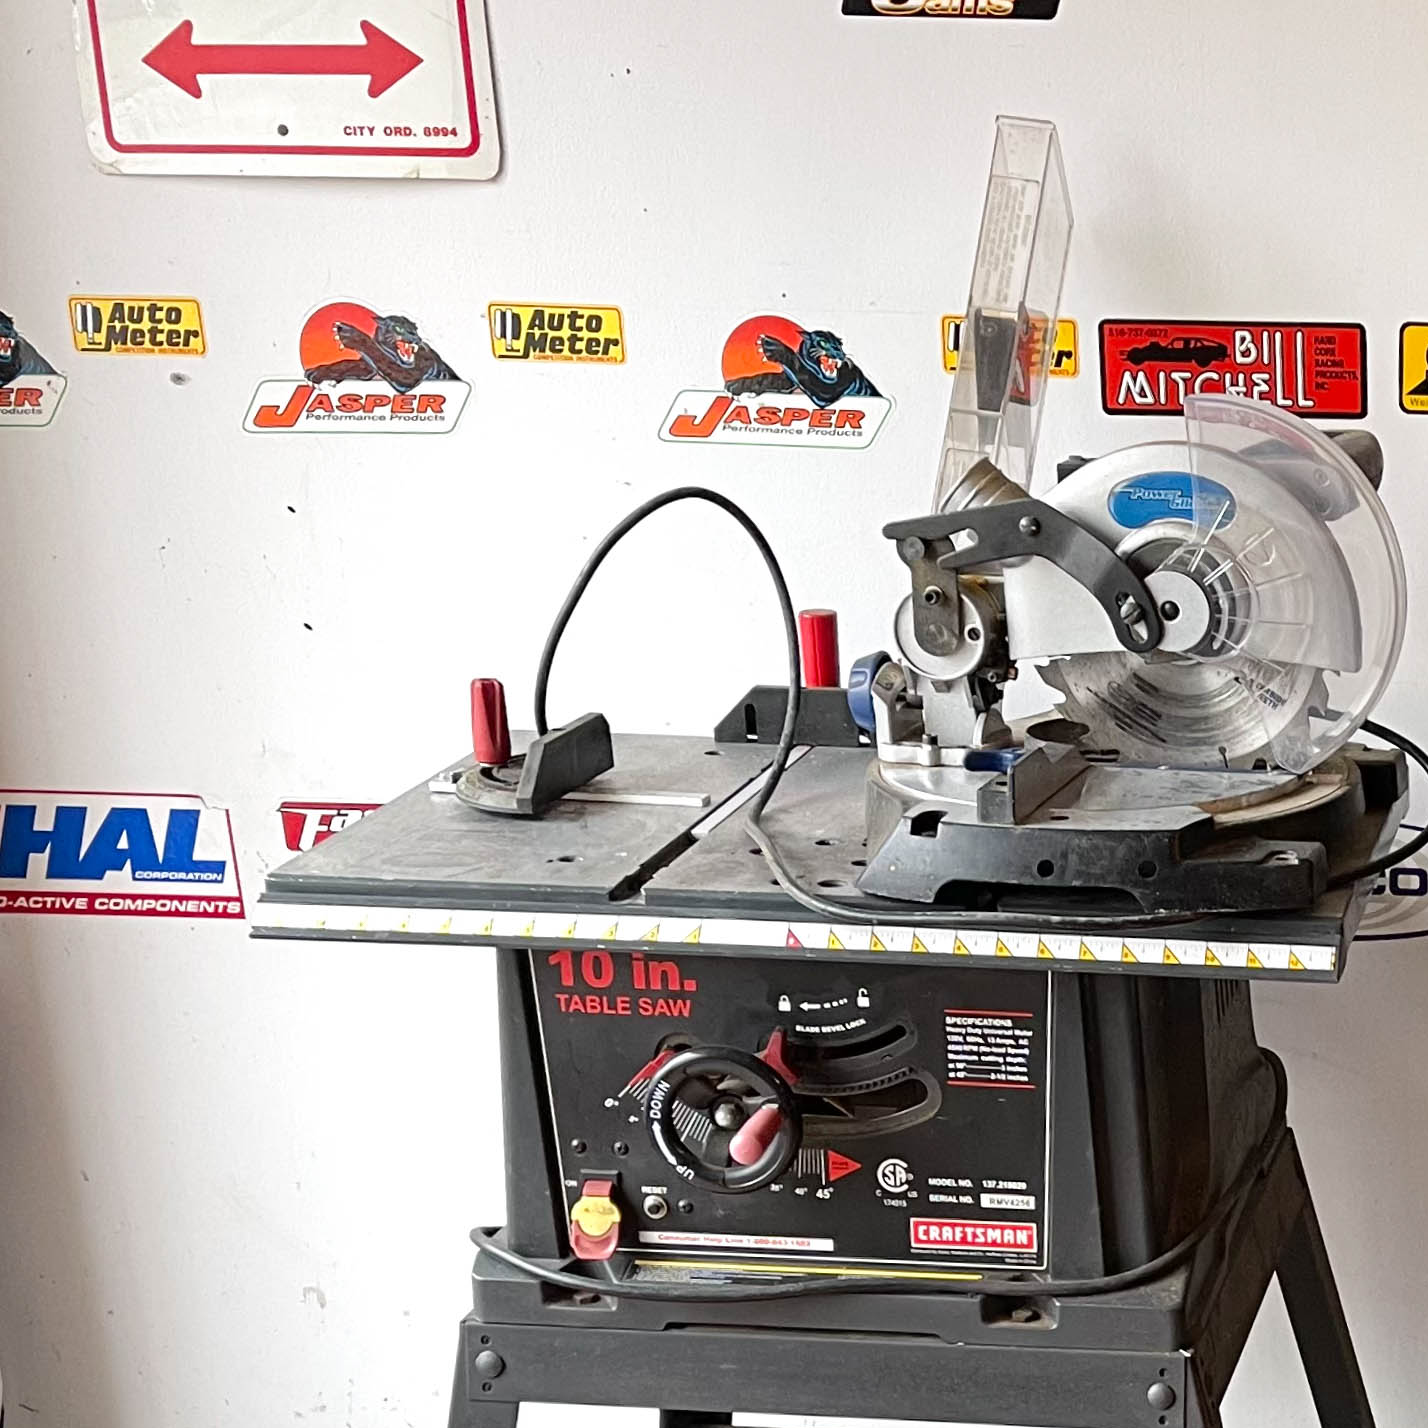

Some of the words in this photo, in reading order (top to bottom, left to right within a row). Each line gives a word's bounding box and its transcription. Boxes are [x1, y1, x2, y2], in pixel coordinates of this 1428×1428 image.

[343, 126, 375, 136] CITY
[383, 126, 417, 137] ORD.
[108, 303, 182, 325] Auto
[527, 309, 603, 333] Auto
[106, 325, 200, 348] Meter
[523, 332, 620, 356] Meter
[1116, 360, 1315, 408] MITCHELL
[253, 384, 446, 427] JASPER
[306, 413, 386, 421] Performance
[390, 413, 445, 421] Products
[669, 395, 865, 438] JASPER
[722, 424, 803, 434] Performance
[807, 427, 863, 437] Products
[135, 871, 222, 881] CORPORATION
[94, 899, 241, 913] COMPONENTS
[548, 950, 614, 988] 10
[631, 953, 697, 991] in.
[555, 993, 632, 1015] TABLE
[638, 998, 692, 1017] SAW
[945, 1016, 1013, 1027] SPECIFICATIONS
[649, 1080, 671, 1119] DOWN
[675, 1165, 695, 1180] UP
[928, 1178, 957, 1187] MODEL
[958, 1179, 974, 1188] NO.
[929, 1194, 959, 1203] SERIAL
[959, 1195, 975, 1204] NO.
[917, 1225, 1029, 1246] CRAFTSMAN
